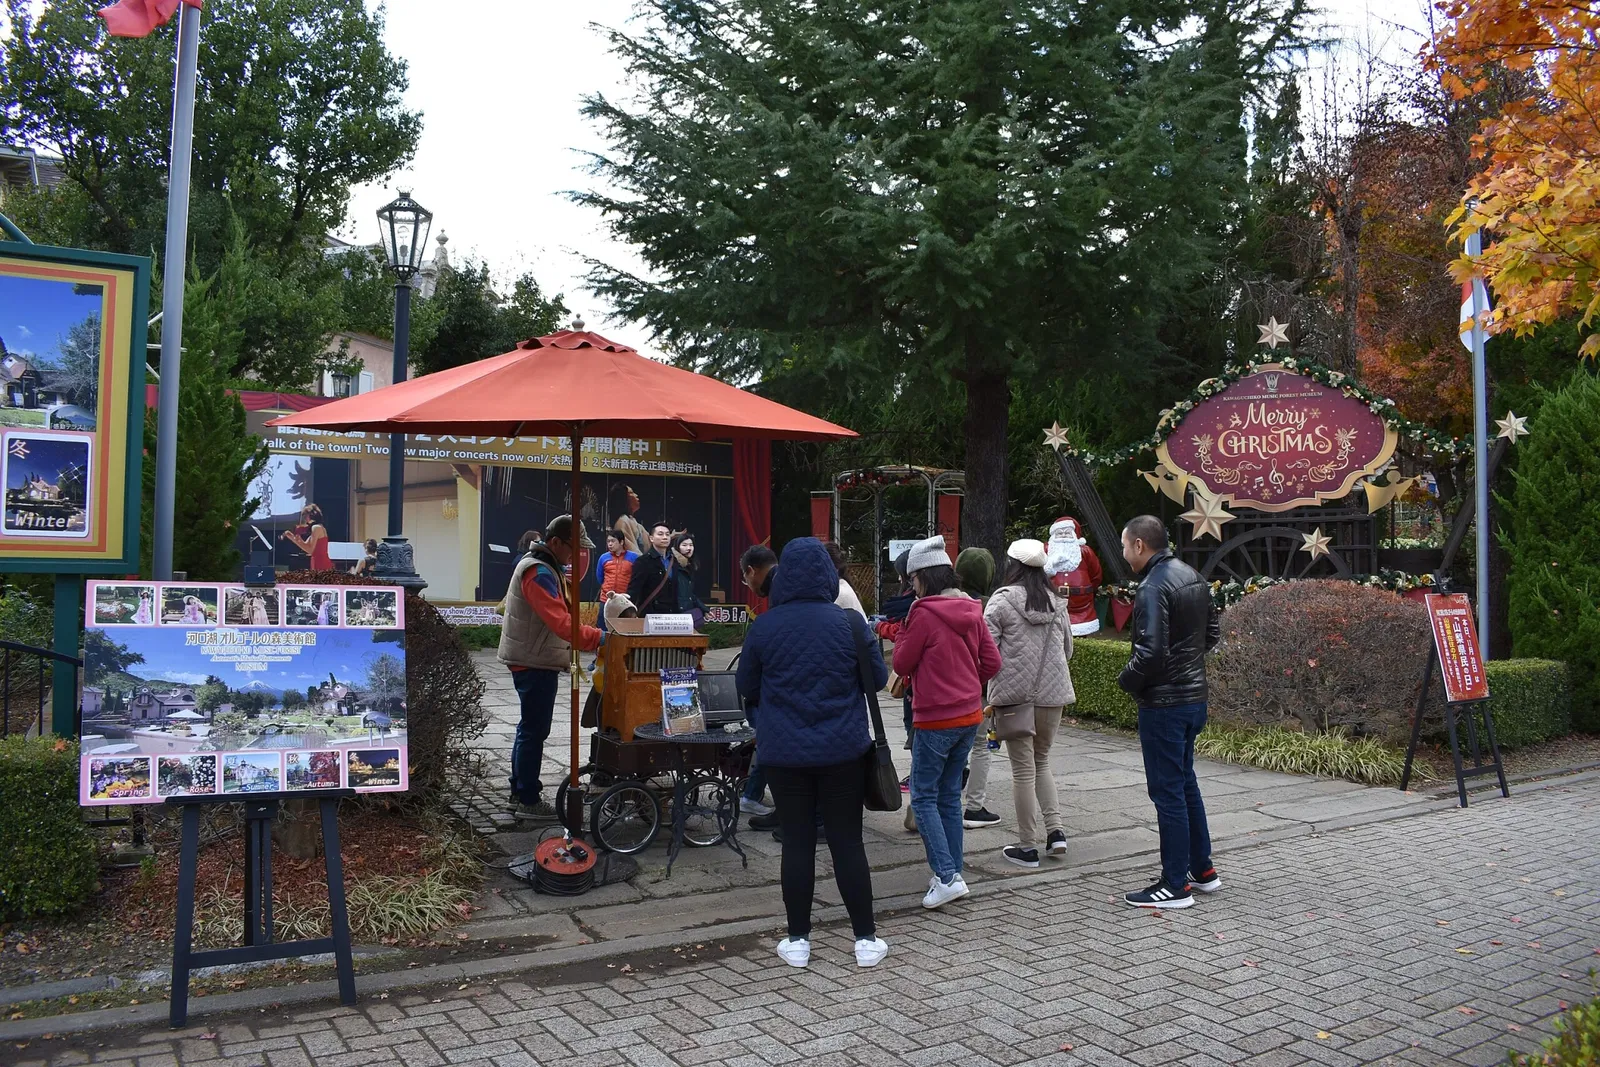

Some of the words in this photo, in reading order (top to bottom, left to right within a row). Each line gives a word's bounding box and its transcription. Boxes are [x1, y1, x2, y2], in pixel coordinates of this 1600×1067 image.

[1242, 402, 1308, 430] Merry
[9, 440, 30, 459] 冬
[262, 438, 286, 449] talk
[289, 439, 303, 449] of
[306, 440, 325, 451] the
[328, 442, 362, 453] town!
[364, 444, 390, 454] Two
[418, 448, 451, 460] major
[453, 450, 499, 461] concerts
[501, 452, 524, 462] now
[1218, 424, 1332, 460] CHRISTMAS
[288, 753, 300, 765] 秋
